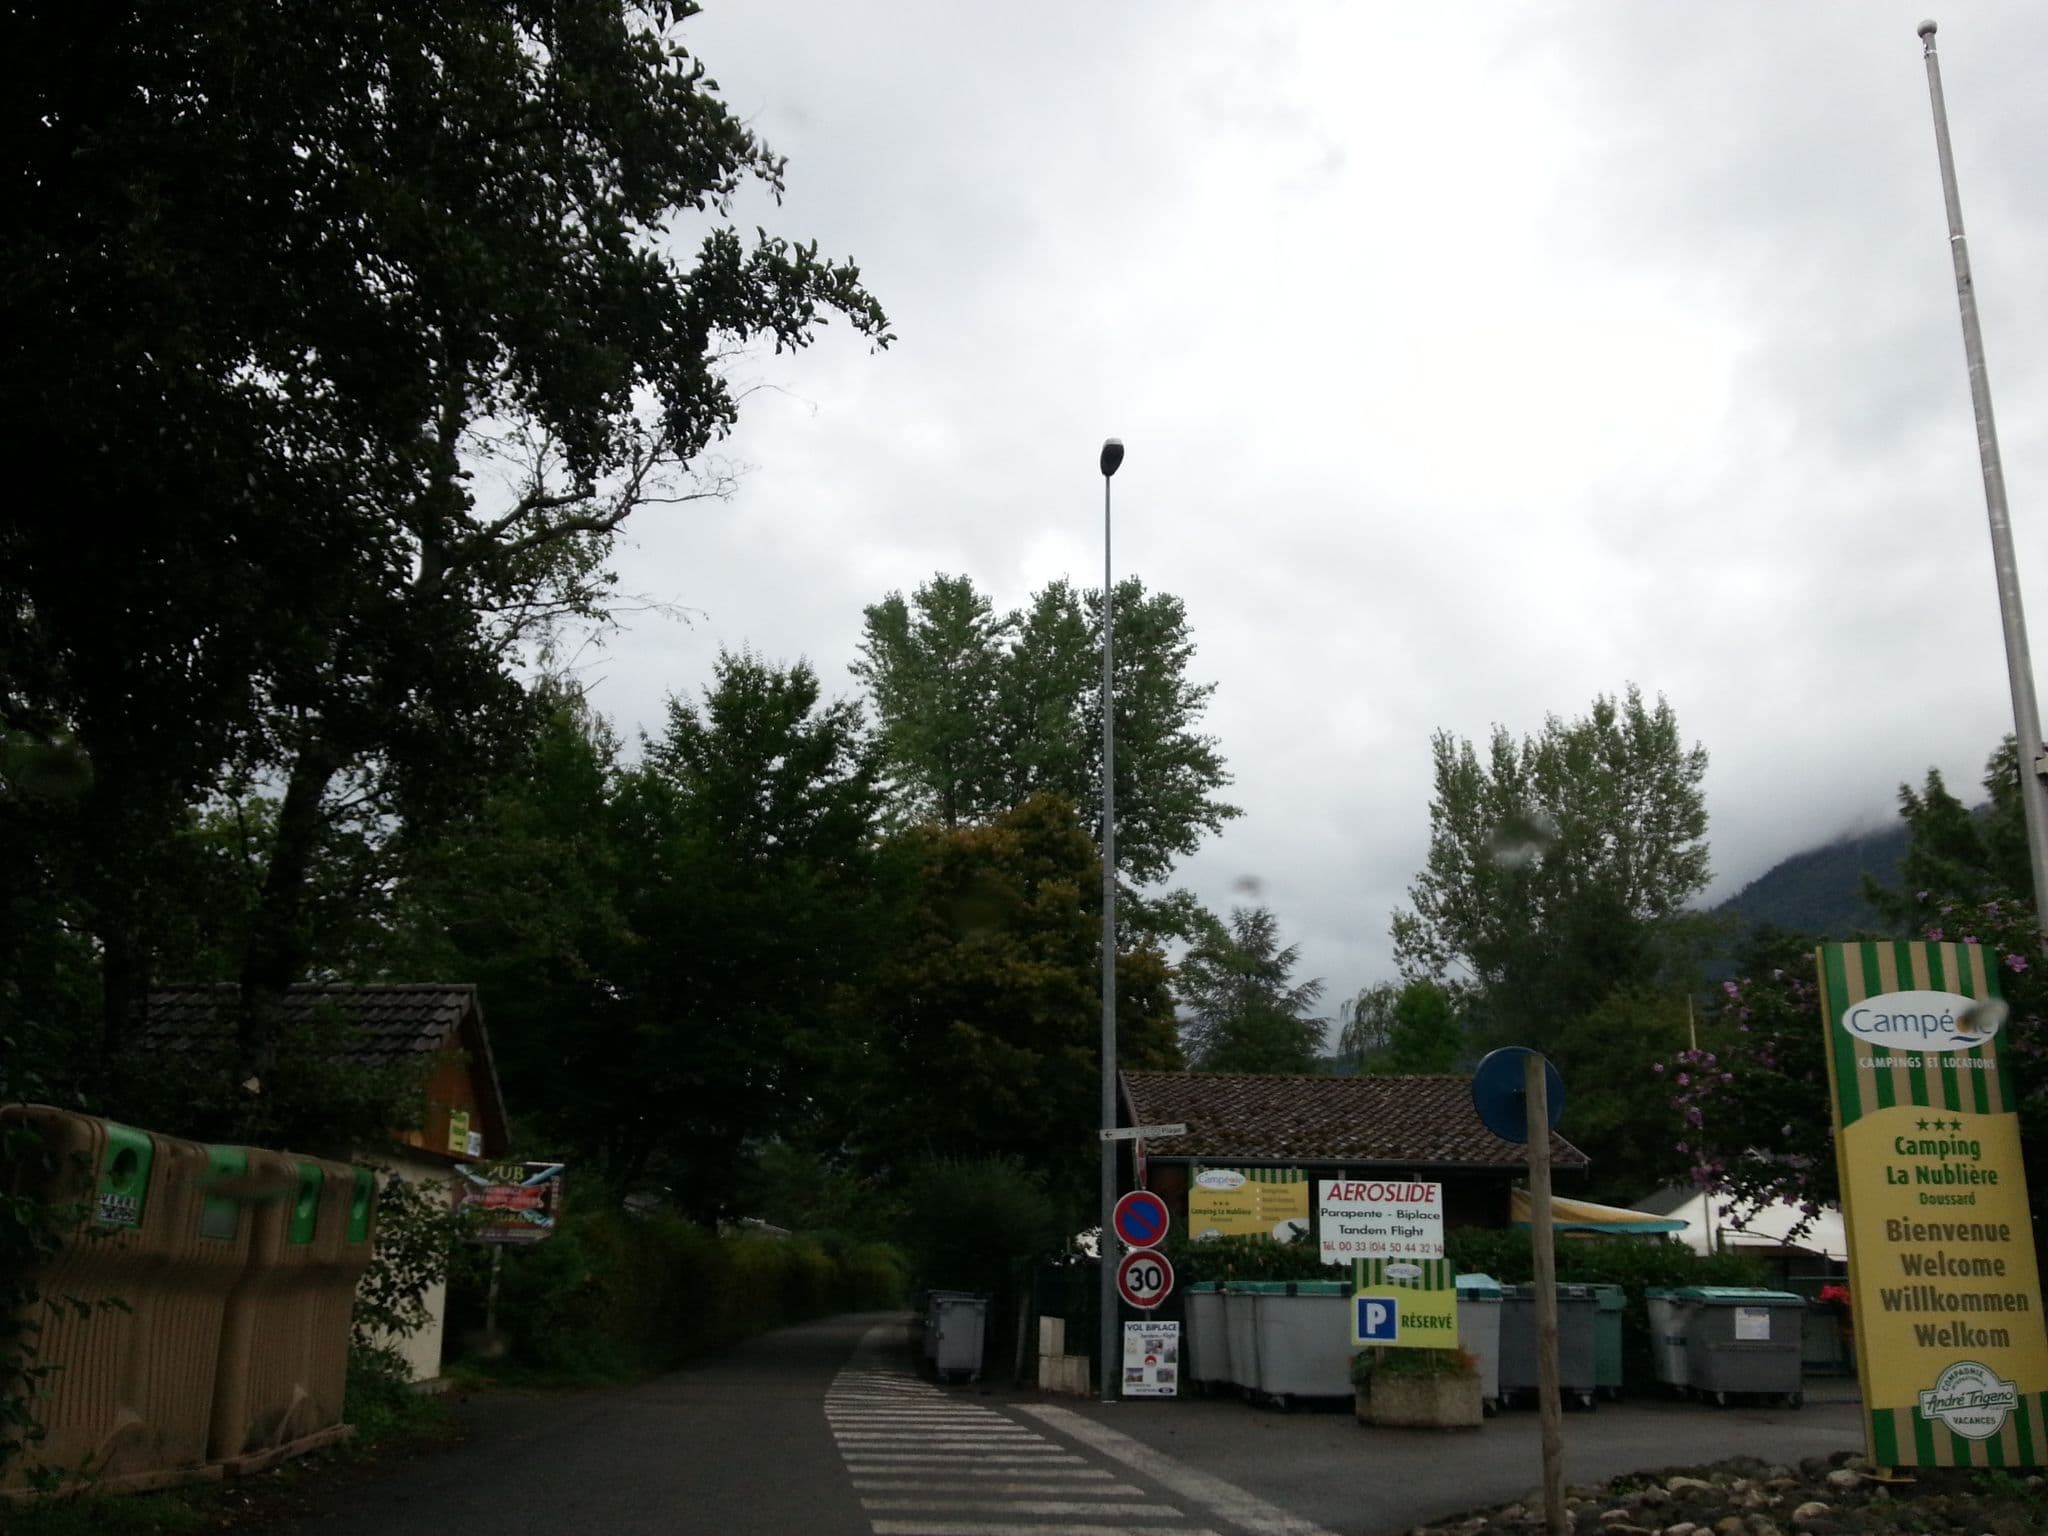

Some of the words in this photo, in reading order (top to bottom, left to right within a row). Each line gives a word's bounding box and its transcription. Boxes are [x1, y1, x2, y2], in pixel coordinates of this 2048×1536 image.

[1852, 1008, 1992, 1038] Campé
[1859, 1057, 1921, 1069] CAMPINGS
[1927, 1057, 1938, 1068] ET
[1944, 1057, 1995, 1069] LOCATIONS
[1895, 1134, 1981, 1161] Camping
[1887, 1166, 1909, 1184] La
[1916, 1163, 1998, 1184] Nublière
[1327, 1183, 1436, 1202] AEROSLIDE
[1920, 1192, 1976, 1205] Doussard
[1321, 1208, 1382, 1219] Parapente
[1397, 1210, 1440, 1220] Biplace
[1339, 1224, 1386, 1235] Tandem
[1392, 1226, 1424, 1237] Flight
[1886, 1216, 2011, 1242] Bienvenue
[1900, 1251, 2006, 1277] Welcome
[1129, 1266, 1161, 1291] 30
[1880, 1285, 2029, 1312] Willkommen
[1146, 1323, 1177, 1332] BIPLACE
[1366, 1302, 1387, 1335] P
[1401, 1312, 1452, 1329] RÉSERVÉ
[1914, 1321, 2010, 1347] Welkom
[1925, 1393, 1965, 1414] André
[1966, 1390, 2013, 1410] Trigano
[1953, 1417, 1996, 1425] VACANCES
